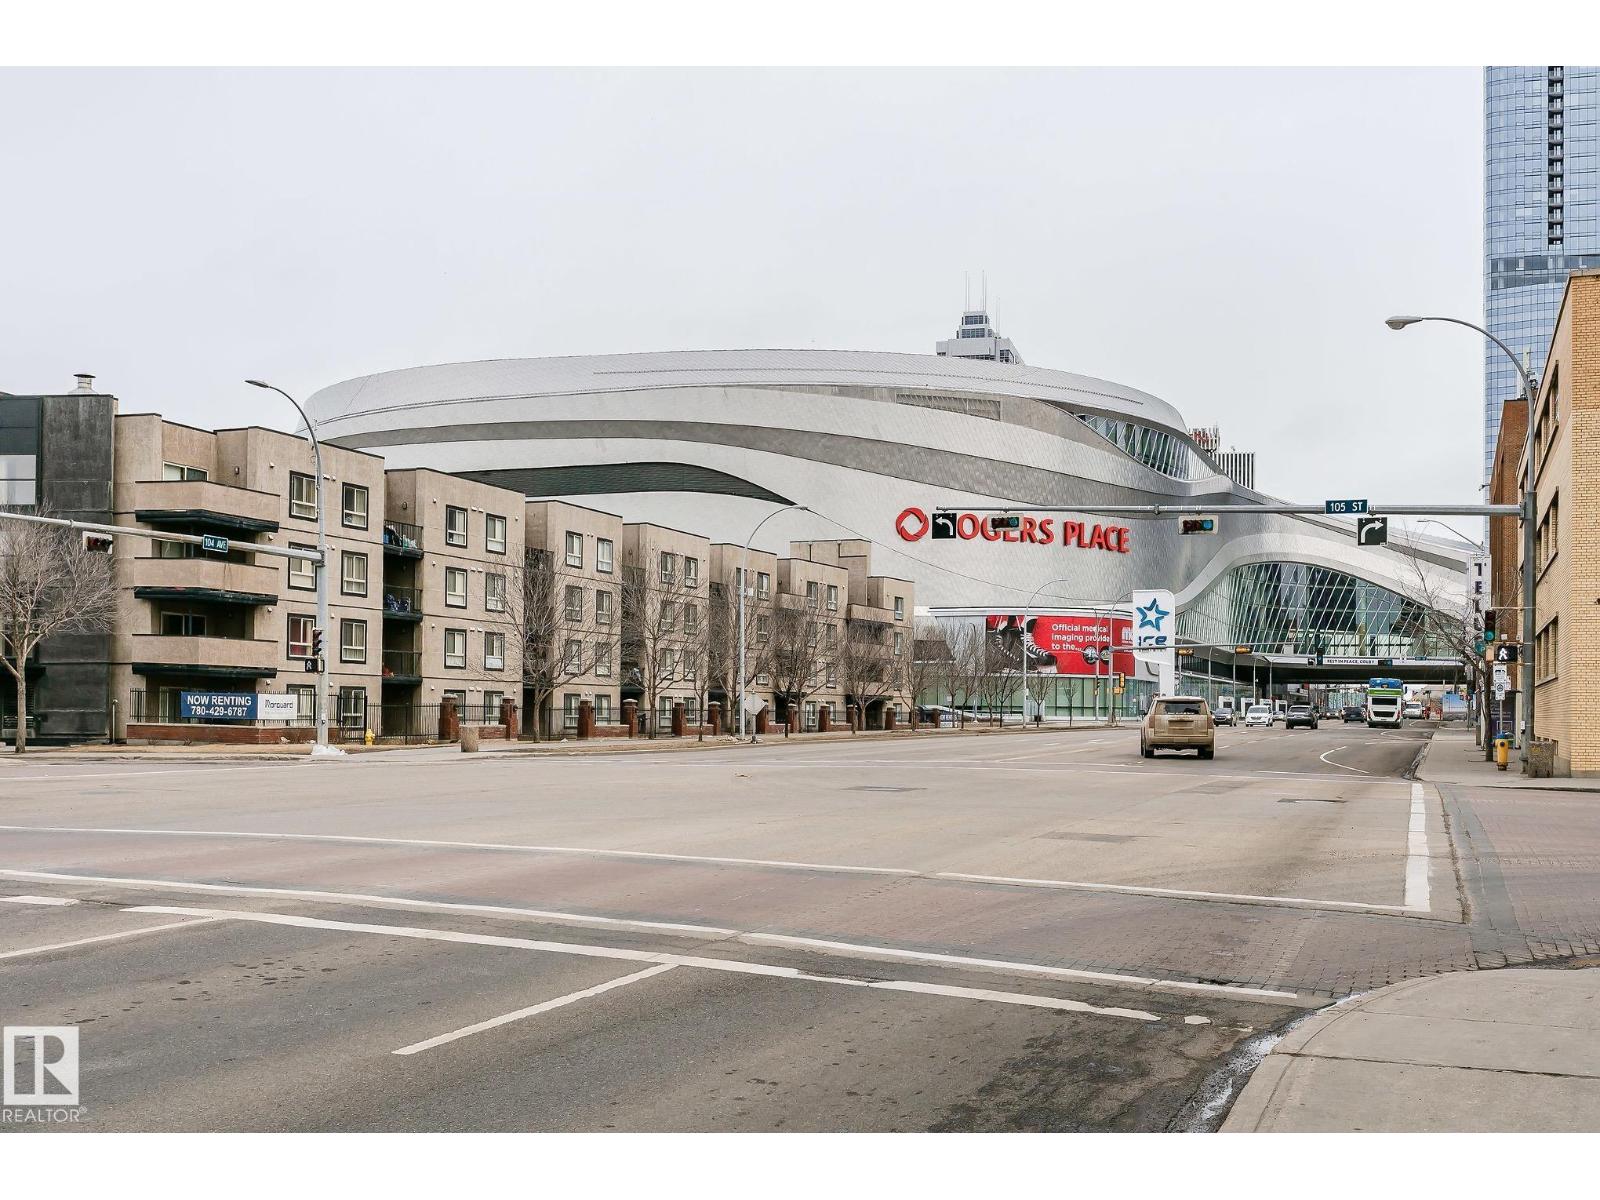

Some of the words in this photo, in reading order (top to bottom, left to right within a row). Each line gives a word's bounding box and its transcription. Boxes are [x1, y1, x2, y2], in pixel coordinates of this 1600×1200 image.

[1330, 502, 1346, 512] 105
[1352, 501, 1363, 511] ST
[1063, 520, 1130, 553] PLACE
[205, 538, 214, 547] 104
[216, 541, 227, 549] AVE
[187, 696, 209, 704] NOW
[211, 696, 252, 705] RENTING
[191, 706, 247, 716] 780-429-6787
